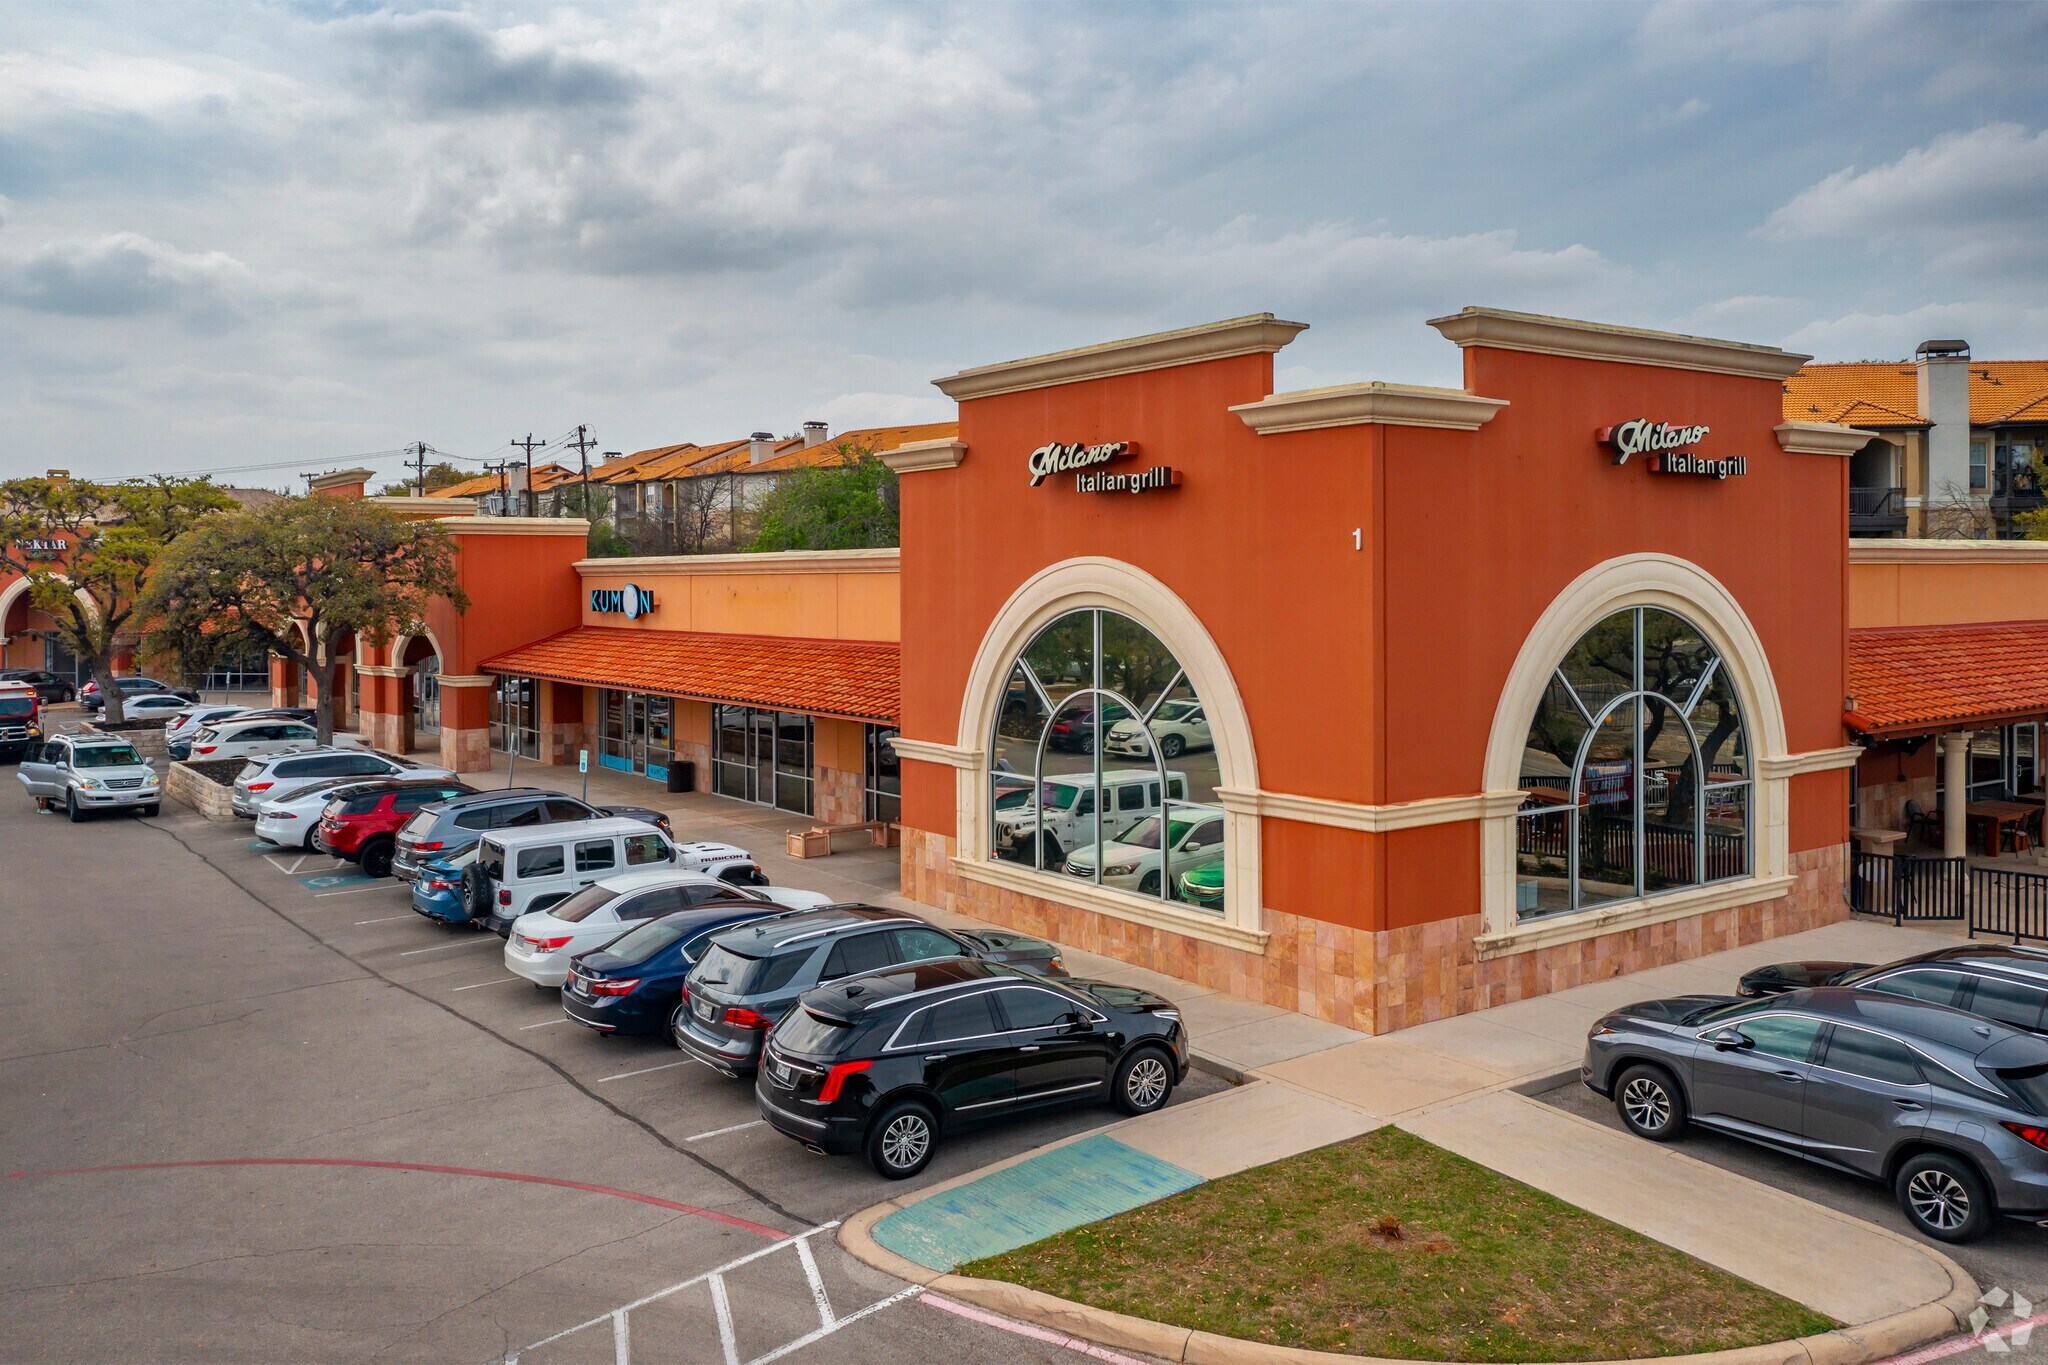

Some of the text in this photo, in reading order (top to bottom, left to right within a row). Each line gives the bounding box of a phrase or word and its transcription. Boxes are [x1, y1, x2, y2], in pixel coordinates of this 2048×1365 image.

[1617, 418, 1710, 465] Milano
[1028, 442, 1121, 487] Milano
[1667, 452, 1747, 480] Italian grill
[1076, 466, 1164, 494] Italian grill
[1352, 527, 1361, 551] 1
[590, 583, 652, 620] KUMON
[700, 854, 743, 863] RUBICON
